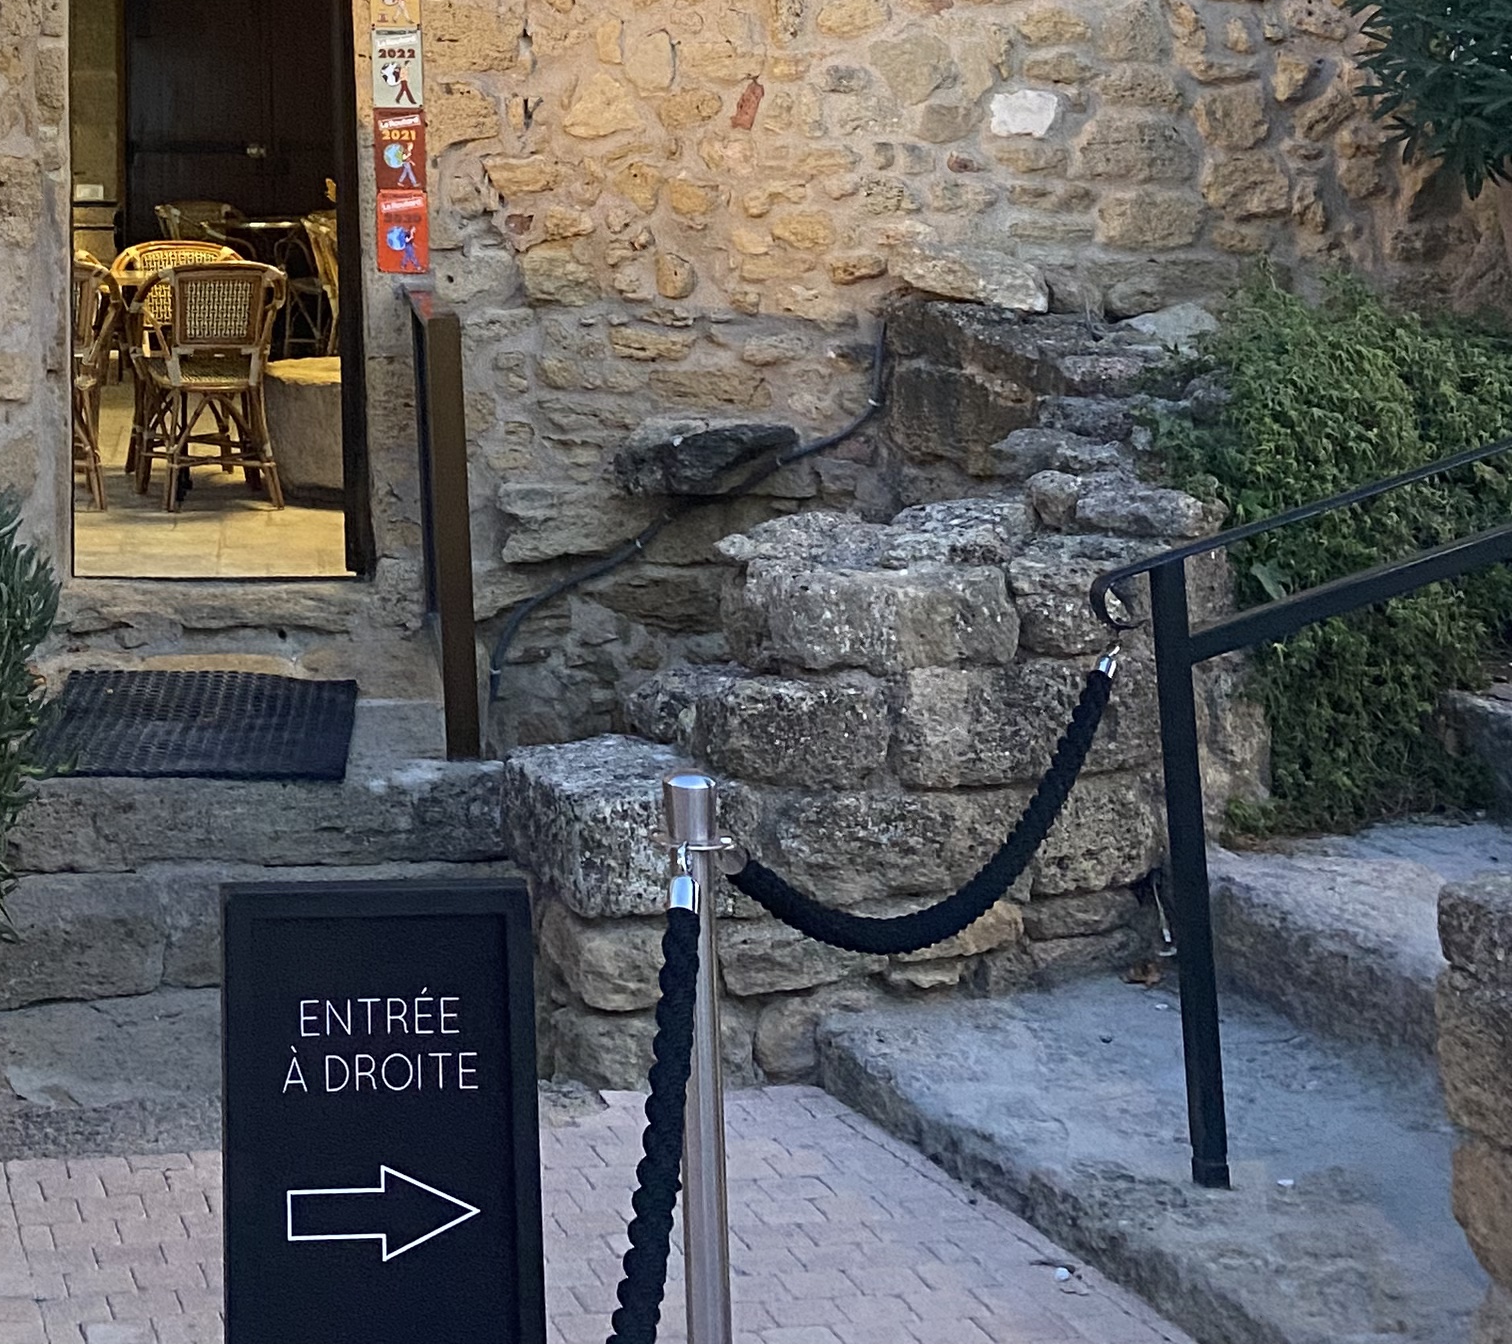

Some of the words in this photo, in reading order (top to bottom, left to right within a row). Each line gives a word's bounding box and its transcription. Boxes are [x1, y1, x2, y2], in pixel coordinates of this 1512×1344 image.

[378, 48, 416, 59] 2022
[381, 129, 417, 141] 2021
[299, 986, 460, 1037] ENTRÉE
[282, 1045, 308, 1094] À
[325, 1051, 479, 1093] DROITE
